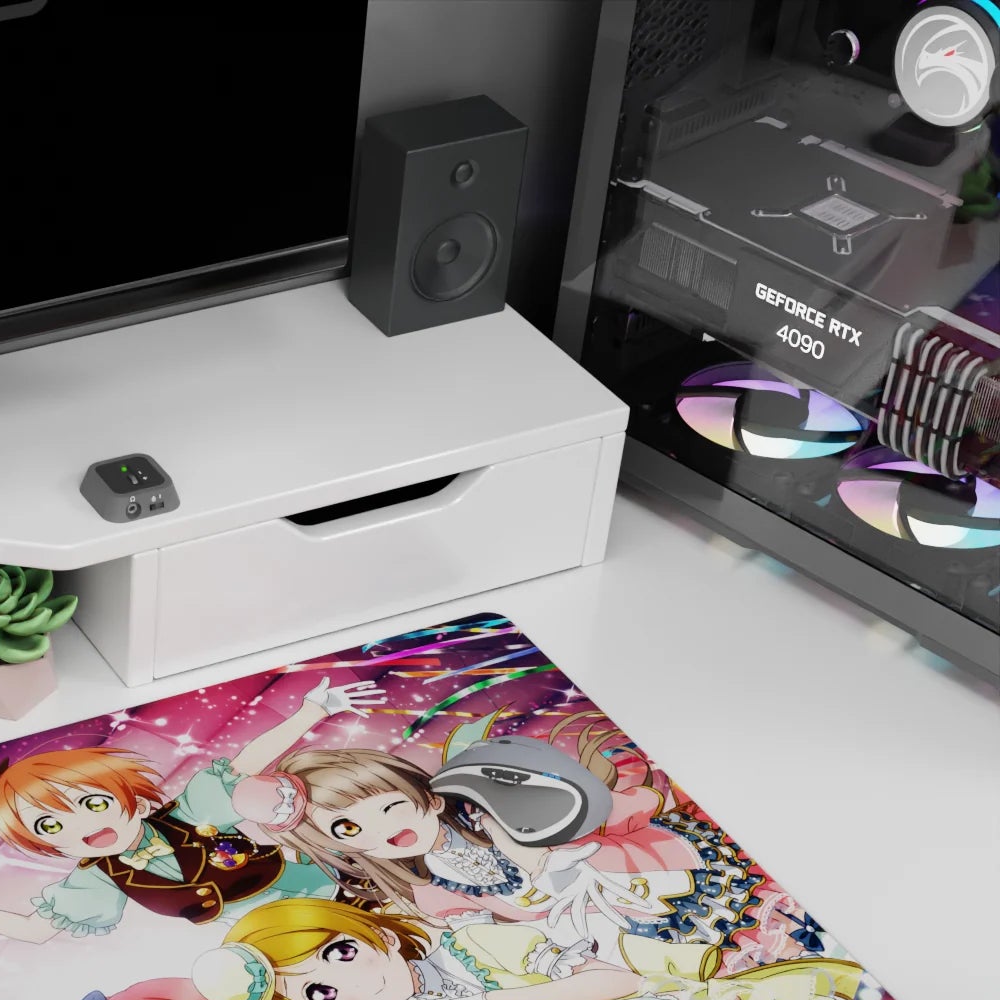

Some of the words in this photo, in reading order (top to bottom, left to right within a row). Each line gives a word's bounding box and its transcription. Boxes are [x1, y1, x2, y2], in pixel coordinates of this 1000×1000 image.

[755, 282, 827, 329] GEFORCE
[828, 317, 863, 347] RTX
[776, 324, 825, 360] 4090
